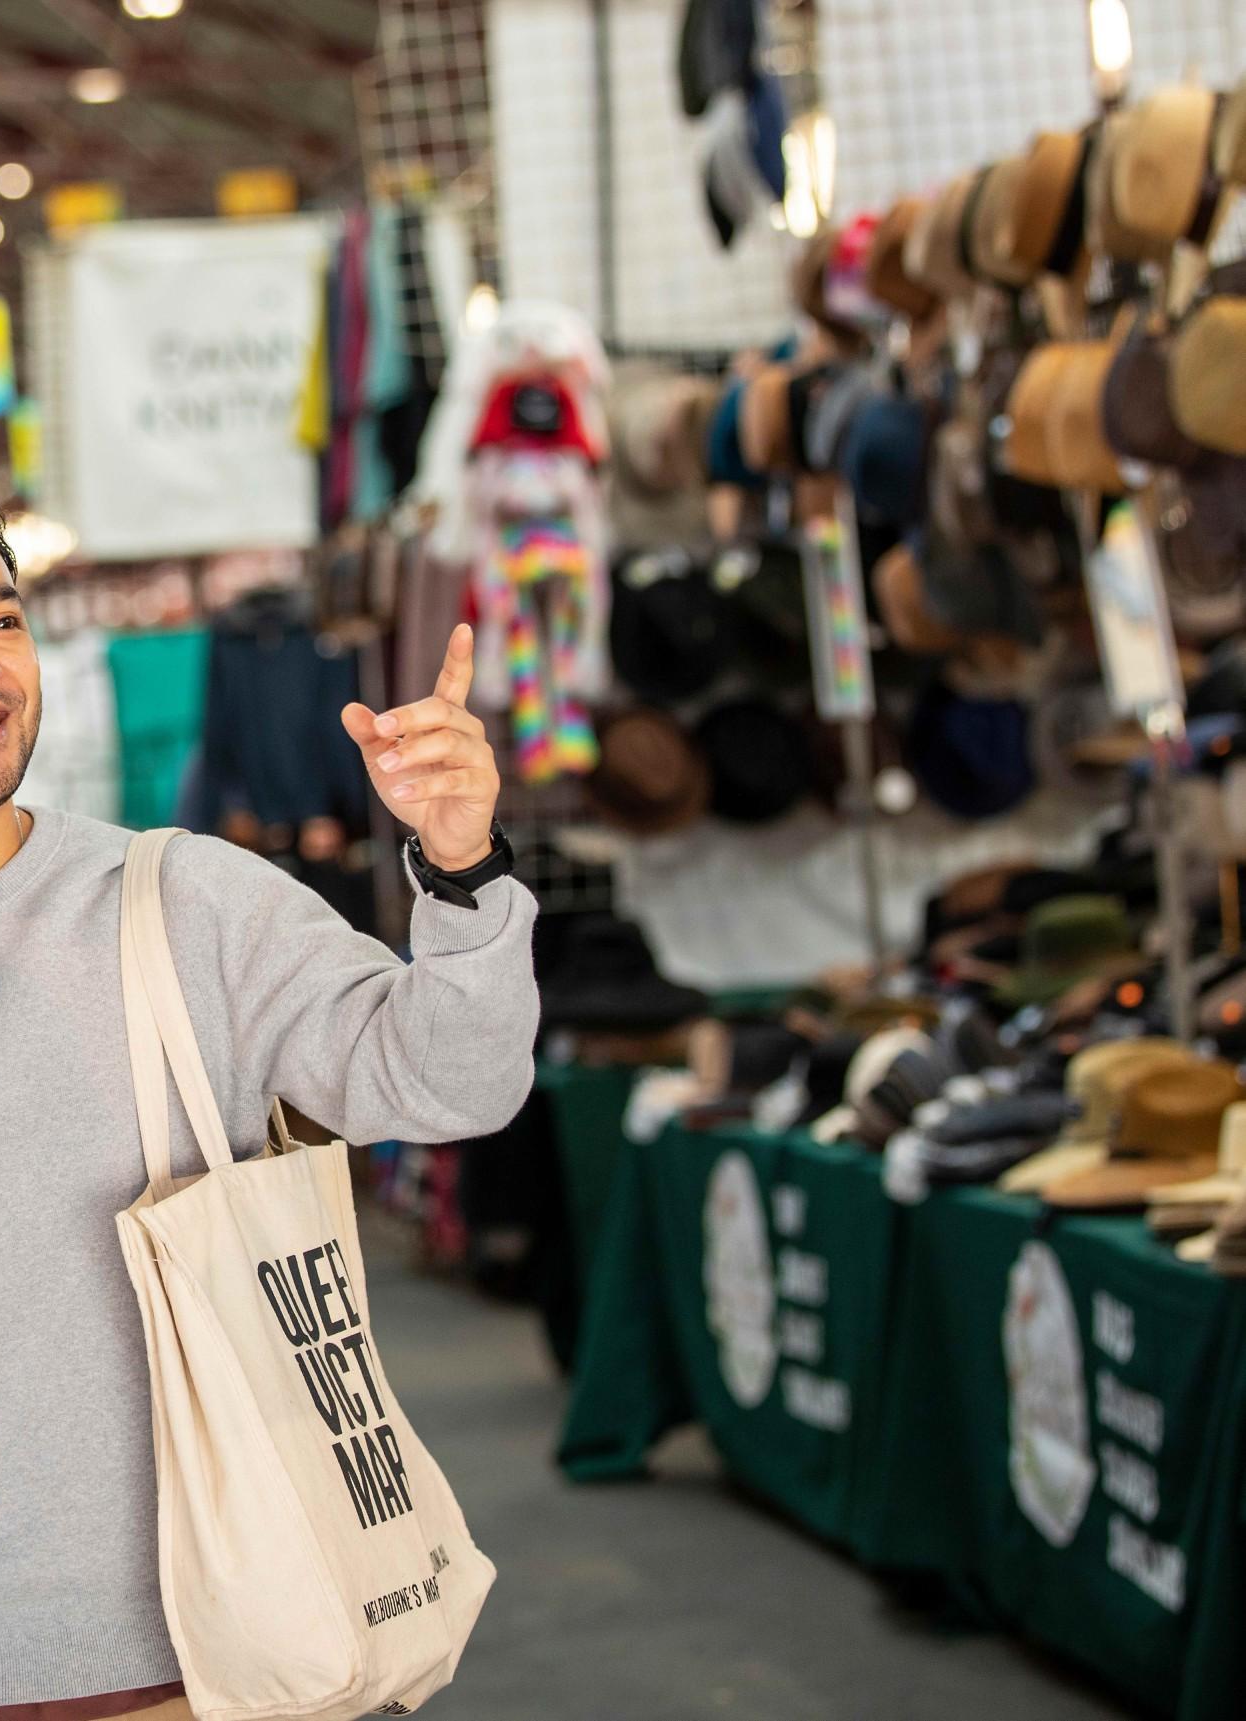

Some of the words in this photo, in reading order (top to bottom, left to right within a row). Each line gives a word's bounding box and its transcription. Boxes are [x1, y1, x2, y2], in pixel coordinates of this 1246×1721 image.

[257, 1238, 361, 1347] QUEE
[294, 1331, 386, 1436] VICT
[363, 1583, 422, 1628] MELBOURNE'S
